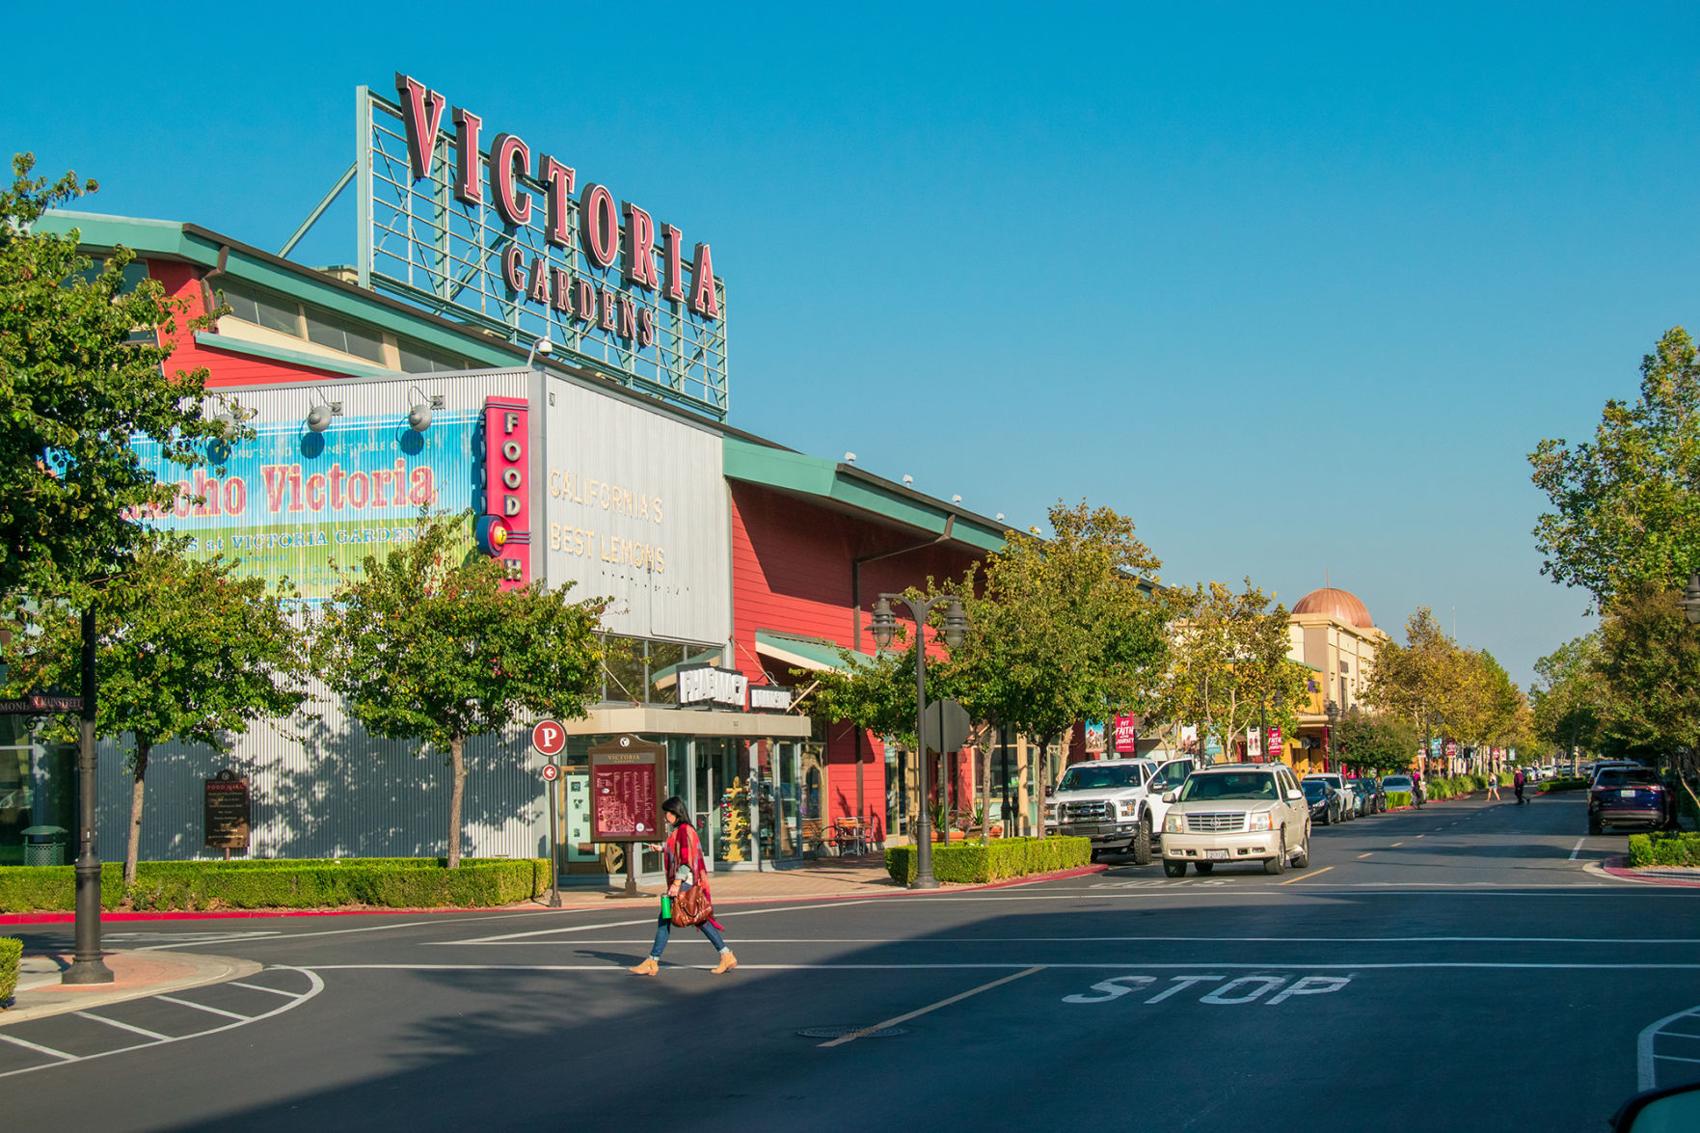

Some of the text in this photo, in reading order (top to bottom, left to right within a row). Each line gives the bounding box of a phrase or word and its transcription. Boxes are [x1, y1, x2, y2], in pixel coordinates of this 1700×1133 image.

[396, 72, 720, 320] VICTORIA
[502, 245, 654, 348] GARDENS
[260, 457, 438, 515] Victoria
[503, 412, 522, 518] FOOD
[232, 529, 329, 551] VICTORIA
[335, 525, 420, 545] GARDEN
[550, 522, 665, 574] BEST LEMONS
[542, 728, 557, 747] P
[1061, 975, 1352, 1005] STOP
